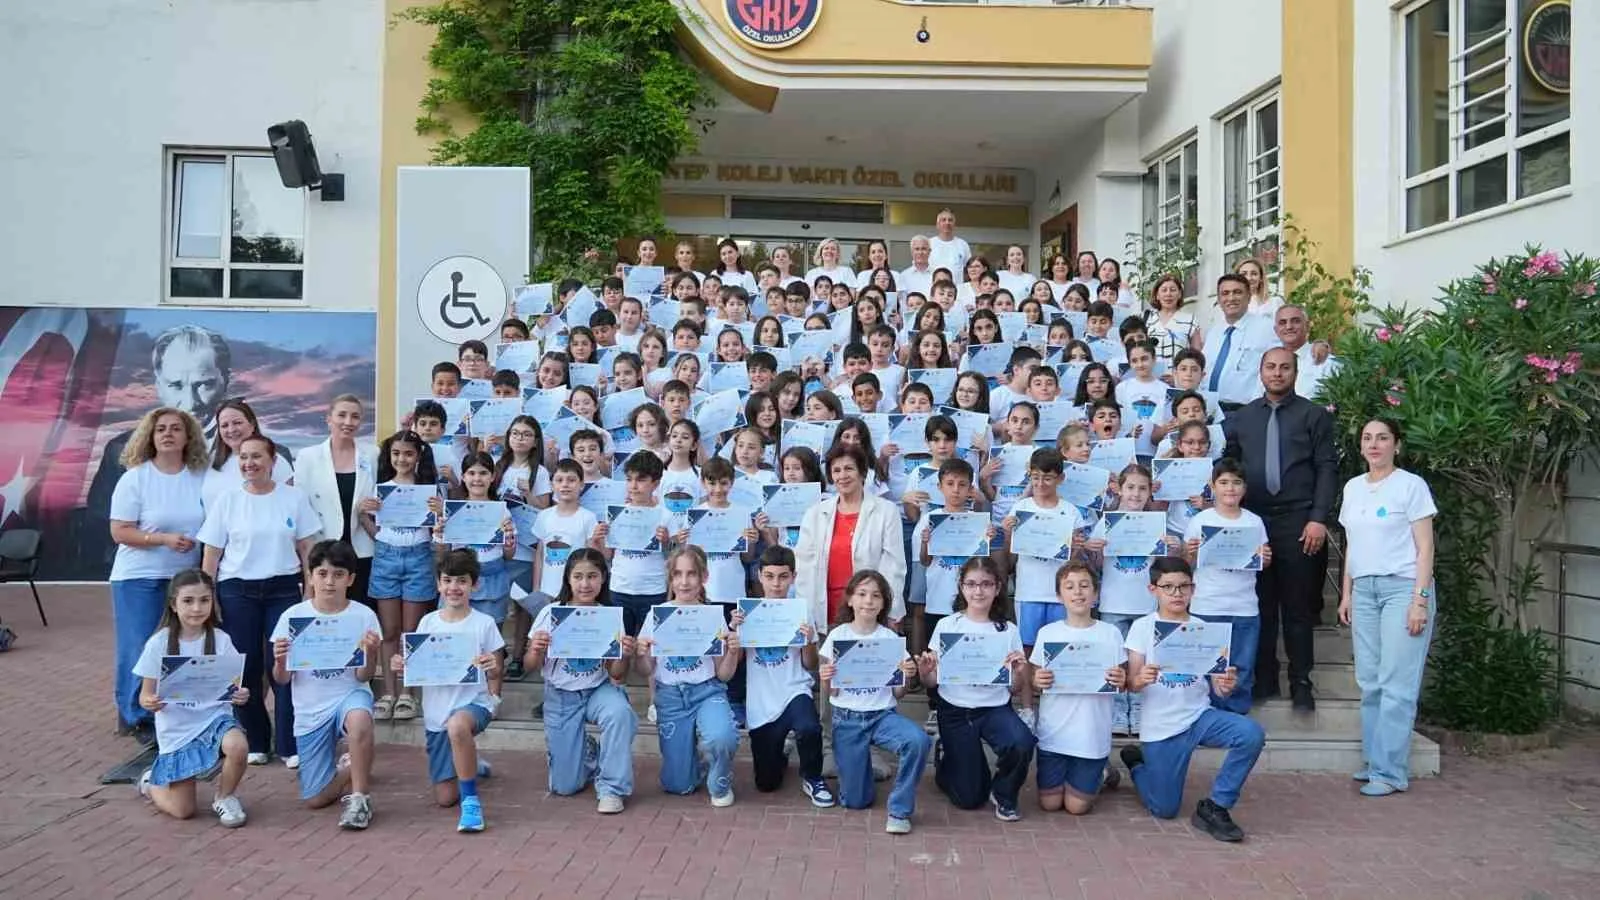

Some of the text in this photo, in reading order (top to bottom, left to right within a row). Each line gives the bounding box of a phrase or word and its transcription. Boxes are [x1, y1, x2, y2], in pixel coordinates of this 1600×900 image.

[717, 164, 783, 182] KOLEJ
[787, 166, 847, 186] VAKFI
[852, 165, 905, 187] ÖZEL
[913, 171, 1018, 193] OKULLARI
